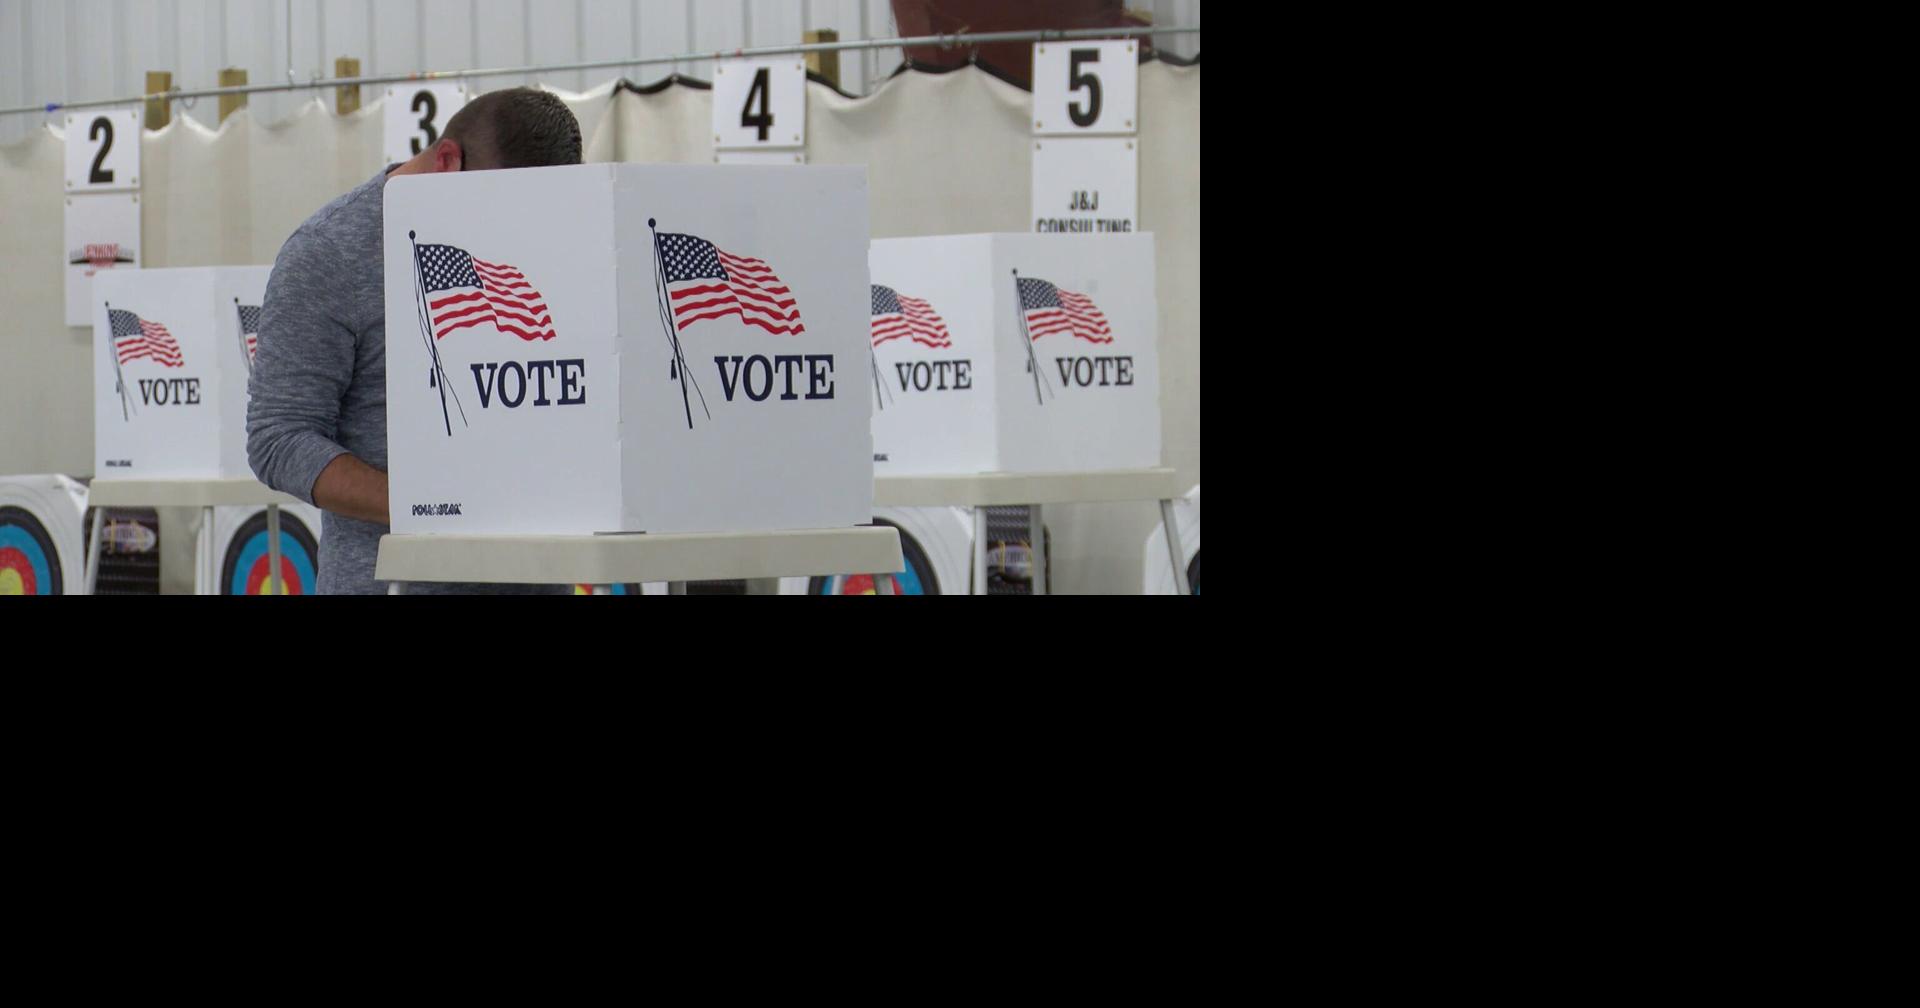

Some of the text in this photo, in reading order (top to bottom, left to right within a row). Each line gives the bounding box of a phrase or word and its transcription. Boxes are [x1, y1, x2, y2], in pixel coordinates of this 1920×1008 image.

[741, 68, 774, 142] 4
[1068, 48, 1102, 128] 5
[410, 90, 437, 156] 3
[88, 116, 114, 184] 2
[1070, 190, 1098, 211] J&J
[139, 378, 200, 406] VOTE
[471, 358, 586, 409] VOTE
[715, 354, 835, 402] VOTE
[896, 360, 972, 392] VOTE
[1056, 357, 1133, 387] VOTE
